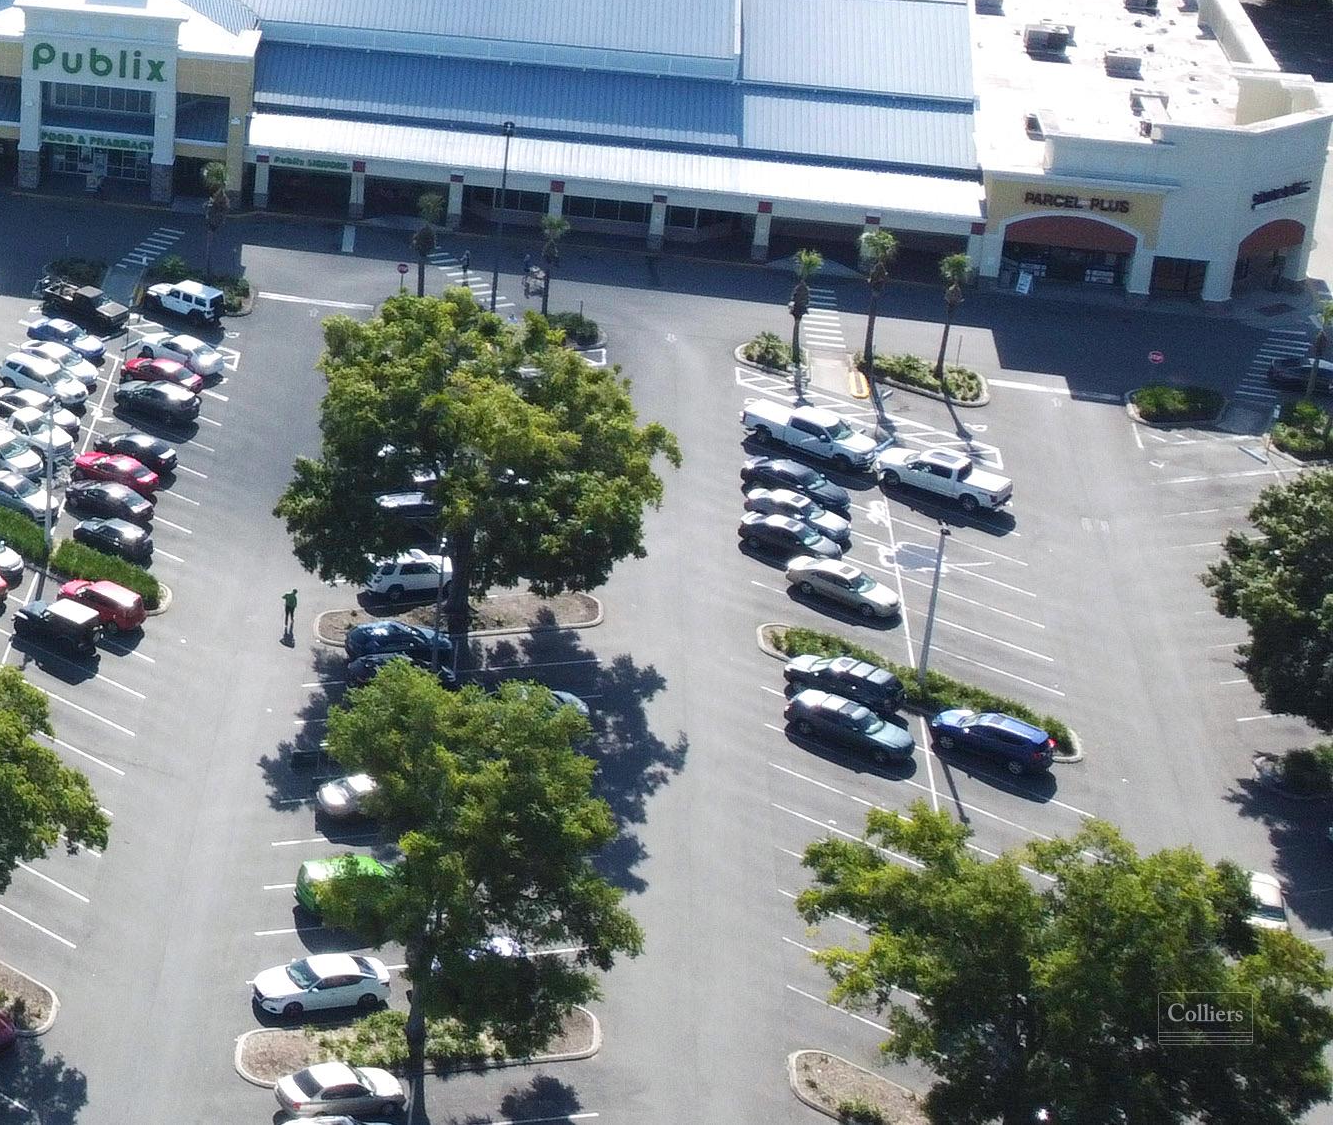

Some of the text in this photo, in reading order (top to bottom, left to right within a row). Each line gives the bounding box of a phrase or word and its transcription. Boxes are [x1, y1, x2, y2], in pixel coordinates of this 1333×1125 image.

[32, 42, 166, 82] Publix
[1024, 192, 1130, 214] PARCEL PLUS
